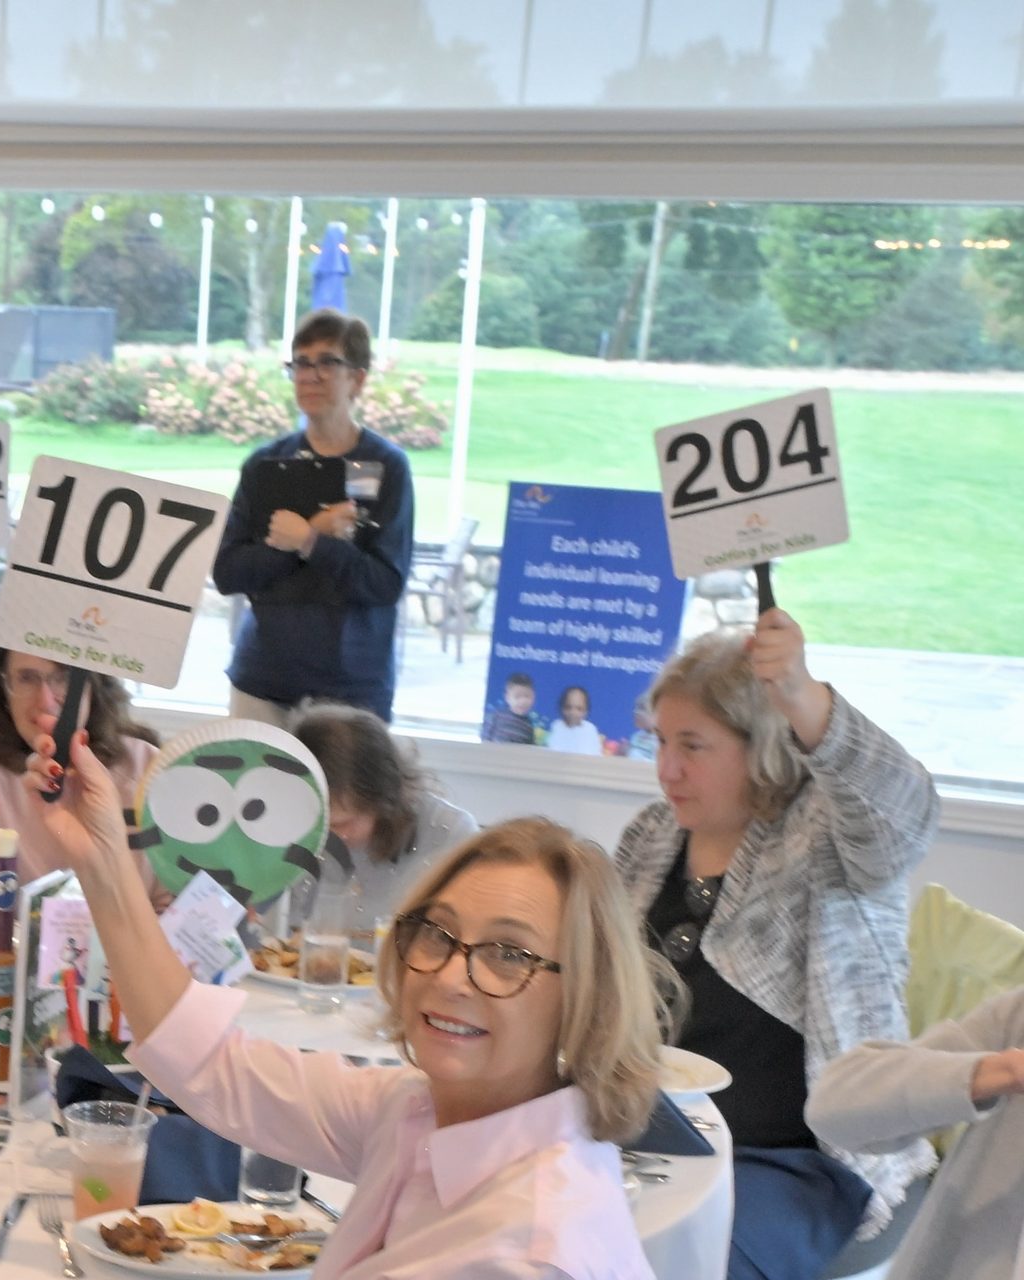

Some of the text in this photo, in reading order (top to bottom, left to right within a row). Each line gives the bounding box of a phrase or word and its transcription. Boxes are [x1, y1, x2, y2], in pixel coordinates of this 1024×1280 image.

[664, 403, 828, 508] 204
[38, 475, 216, 592] 107
[551, 535, 641, 559] Each child's
[523, 560, 661, 593] individual learning
[519, 590, 658, 620] needs are met by a
[508, 616, 663, 646] team of highly skilled
[24, 631, 81, 660] Golfing
[85, 646, 107, 662] for
[111, 653, 145, 674] Kids
[496, 643, 558, 663] teachers
[559, 650, 589, 666] and
